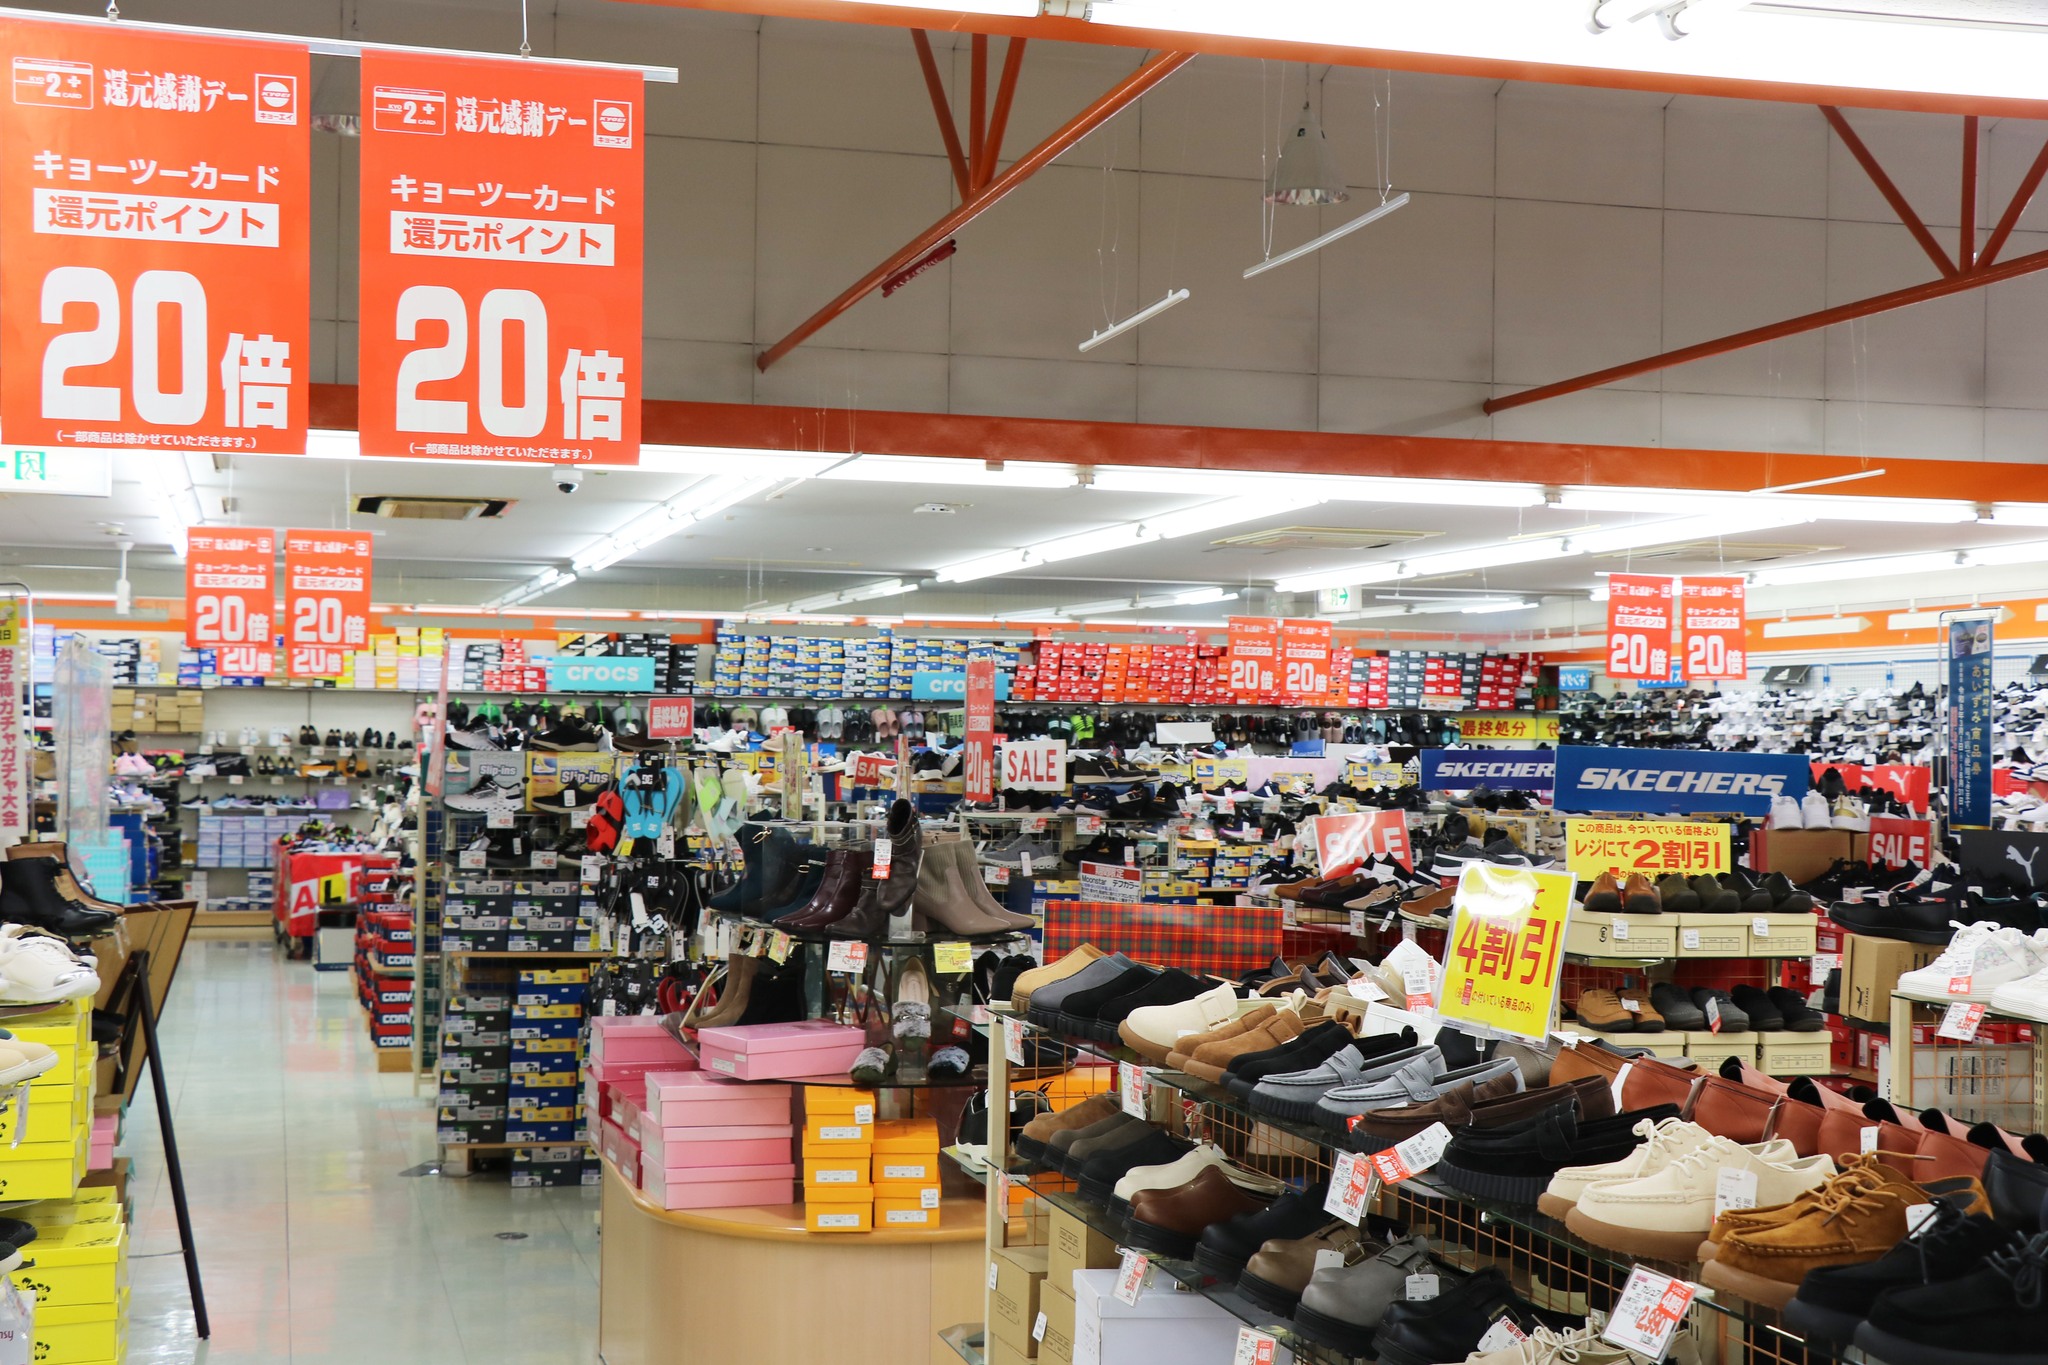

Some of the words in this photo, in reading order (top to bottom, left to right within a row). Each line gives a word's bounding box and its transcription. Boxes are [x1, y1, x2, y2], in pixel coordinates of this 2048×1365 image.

[46, 73, 61, 98] 2
[104, 68, 248, 112] 還元感謝デー
[403, 101, 416, 124] 2
[455, 96, 586, 137] 還元感謝デー
[33, 150, 280, 193] キョーツーカード
[391, 174, 615, 214] キョーツーカード
[48, 195, 265, 238] 還元ポイント
[403, 217, 602, 258] 還元ポイント
[41, 266, 292, 430] 20倍
[395, 285, 626, 442] 20倍
[56, 430, 257, 449] (一部商品は除かせていただきます。)
[409, 442, 593, 460] (一部商品は除かせていただきます。)
[195, 595, 269, 642] 20倍
[294, 597, 365, 644] 20倍
[1610, 633, 1667, 676] 20倍
[1687, 635, 1743, 675] 20倍
[566, 665, 639, 682] crocs
[929, 678, 967, 693] cro
[1230, 660, 1273, 690] 20倍
[1286, 662, 1327, 692] 20倍
[1461, 719, 1526, 736] 最終処分
[479, 764, 517, 776] Slip-ins
[561, 769, 609, 785] Slip-ins
[857, 762, 881, 779] SA
[1007, 749, 1057, 783] SALE
[1435, 761, 1555, 778] SKECHER
[1577, 767, 1787, 796] SKECHERS
[1325, 826, 1405, 866] SALE
[1577, 823, 1719, 836] この商品は、今ついている価格より
[1575, 838, 1721, 870] レジにて2割引
[1871, 833, 1925, 868] SALE
[1456, 912, 1561, 988] 4割引
